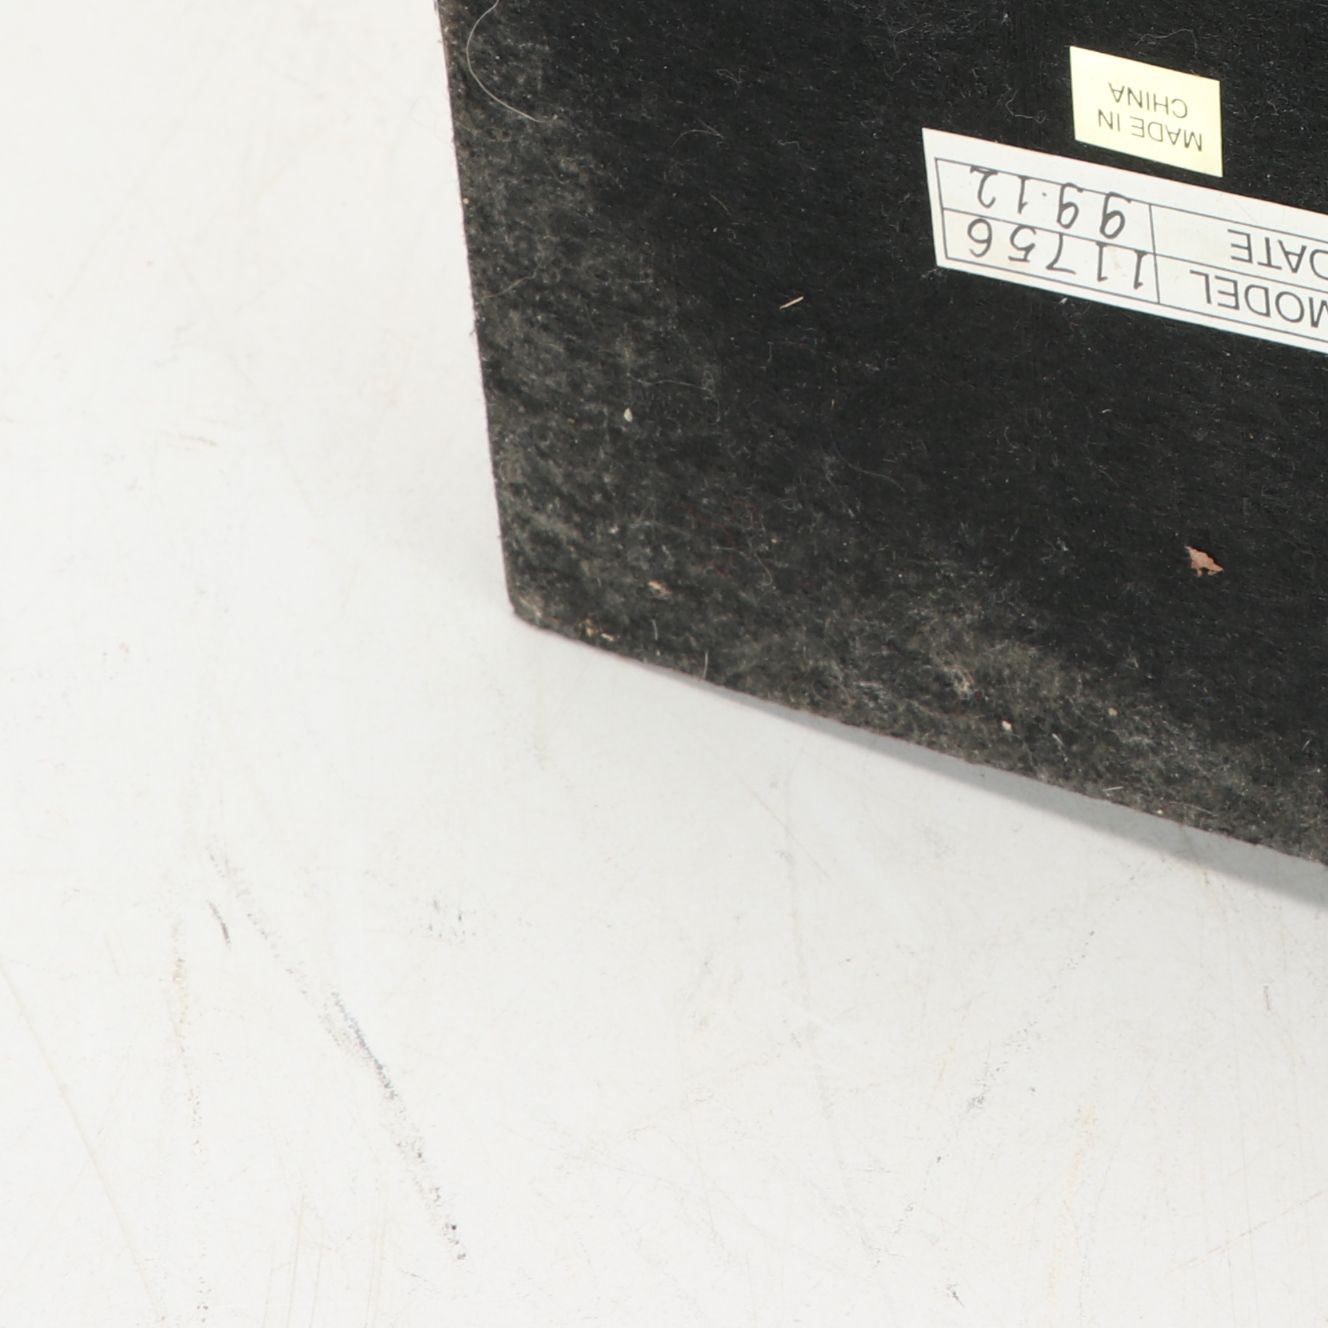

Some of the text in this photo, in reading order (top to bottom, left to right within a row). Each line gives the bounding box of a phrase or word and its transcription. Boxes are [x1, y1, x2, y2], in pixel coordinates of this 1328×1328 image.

[1108, 81, 1188, 119] CHINA
[1098, 108, 1203, 152] MADE IN
[967, 218, 1149, 290] 11756
